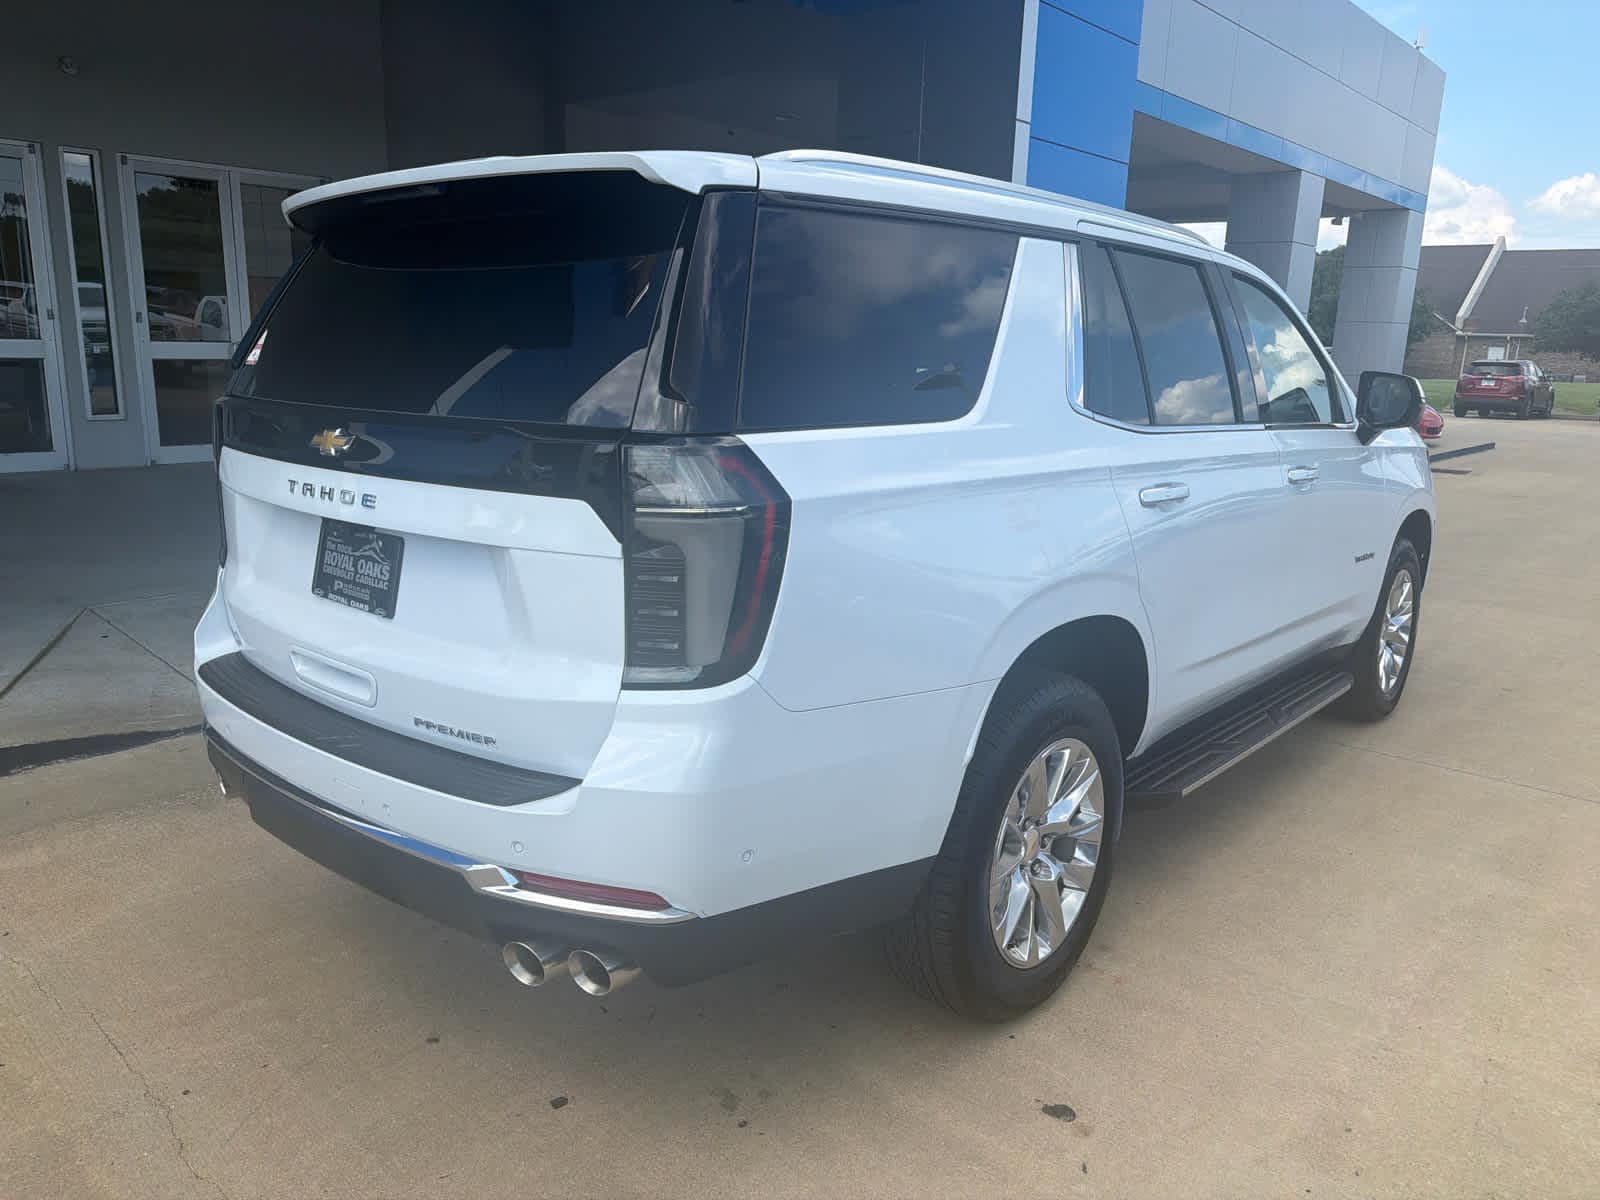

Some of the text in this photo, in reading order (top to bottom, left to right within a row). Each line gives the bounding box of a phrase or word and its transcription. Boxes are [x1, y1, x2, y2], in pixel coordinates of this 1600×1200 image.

[288, 479, 377, 509] TAHOE
[324, 551, 391, 581] ROYAL OAKS
[355, 574, 389, 590] CADILLAC
[328, 594, 349, 605] ROYAL
[414, 717, 497, 745] PREMIER
